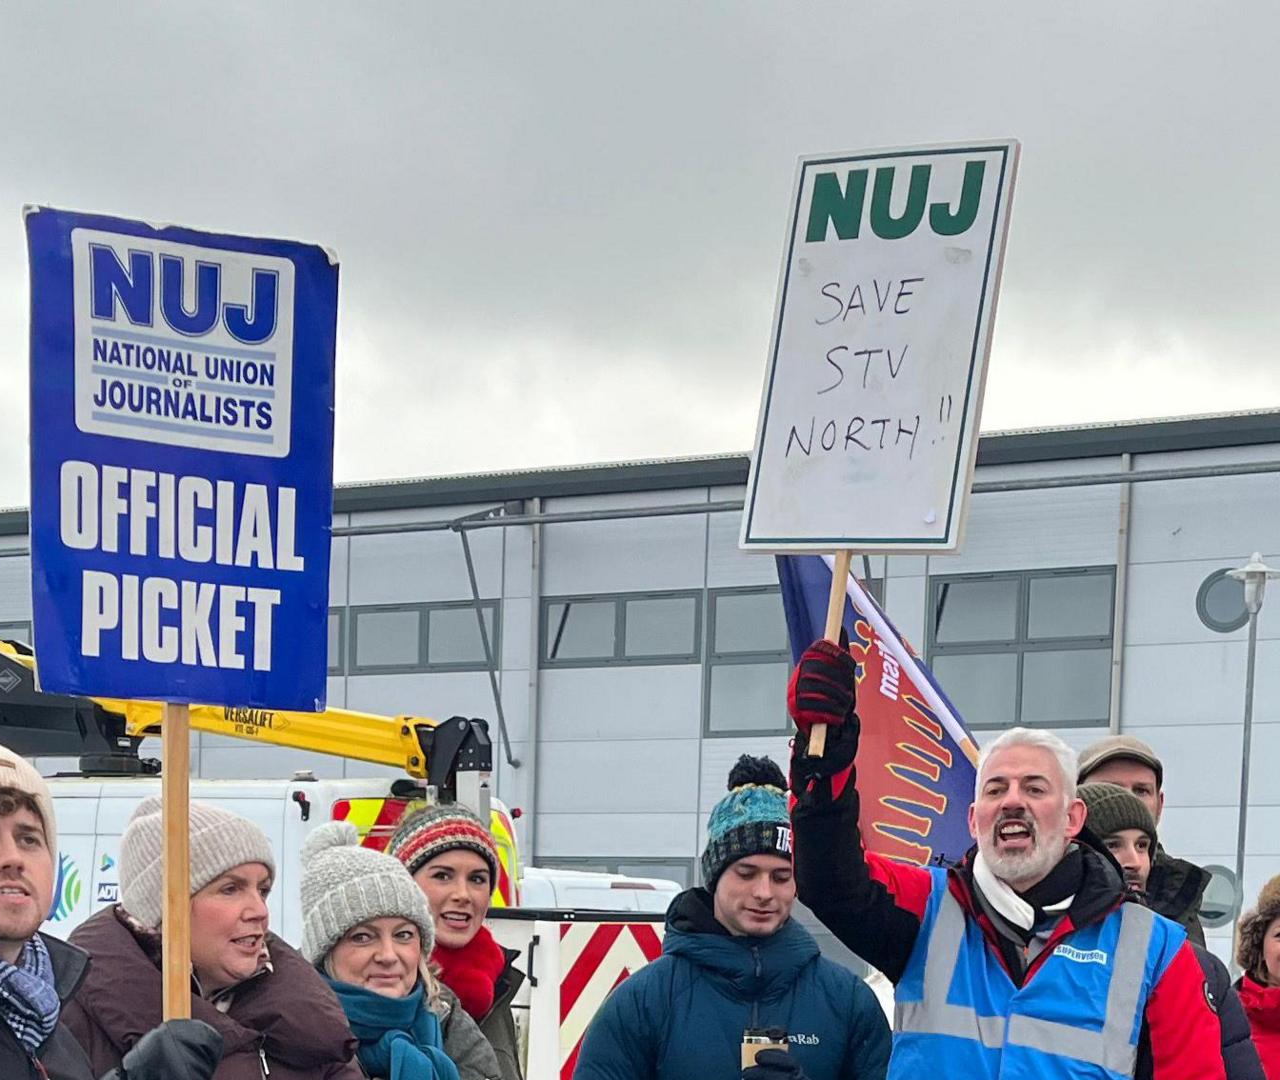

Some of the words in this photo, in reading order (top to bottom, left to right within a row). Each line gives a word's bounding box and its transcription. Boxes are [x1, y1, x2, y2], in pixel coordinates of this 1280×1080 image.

[805, 160, 986, 242] NUJ
[89, 242, 280, 345] NUJ
[815, 277, 924, 325] SAVE
[93, 338, 198, 377] NATIONAL
[205, 356, 275, 386] UNION
[172, 378, 192, 389] OF
[817, 345, 908, 394] STV
[93, 379, 273, 430] JOURNALISTS
[60, 461, 304, 572] OFFICIAL
[81, 569, 281, 672] PICKET
[223, 705, 274, 729] VERSALIFT
[99, 885, 119, 900] ADT
[1056, 945, 1105, 962] SUPERVISOR
